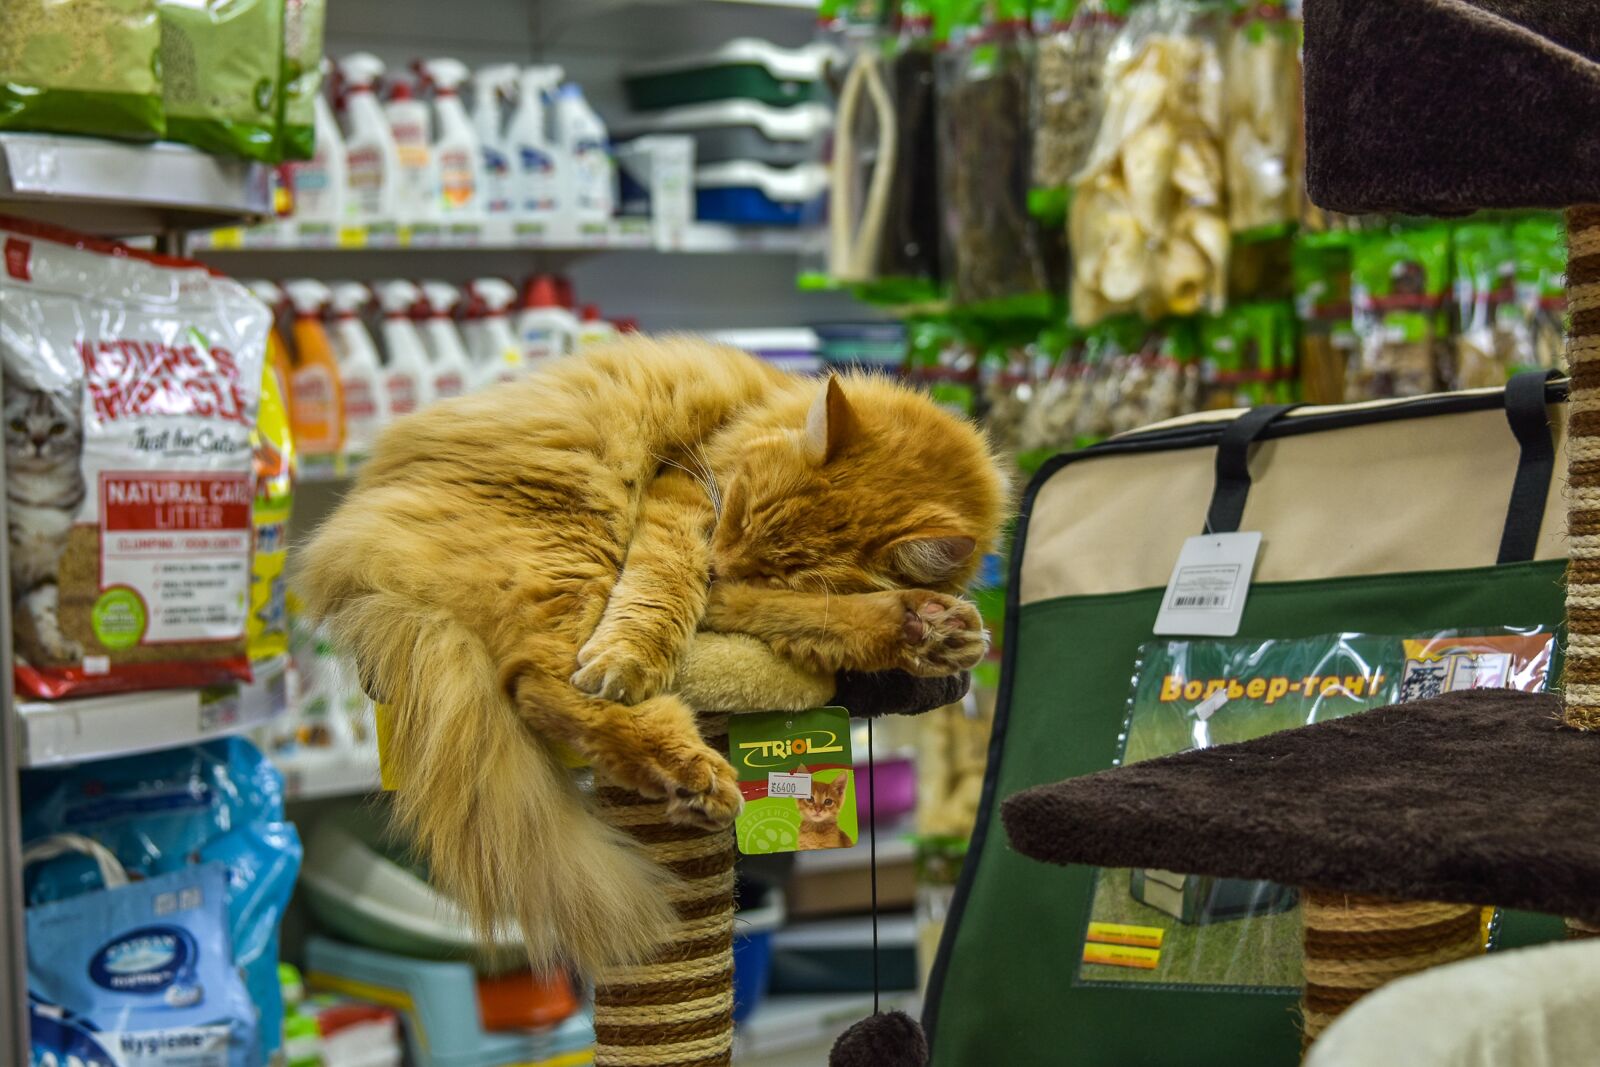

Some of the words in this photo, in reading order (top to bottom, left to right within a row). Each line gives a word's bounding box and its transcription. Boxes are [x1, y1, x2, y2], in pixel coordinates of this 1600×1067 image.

[108, 480, 208, 505] NATURAL
[209, 480, 249, 505] CAR
[155, 504, 224, 528] LITTER
[1160, 674, 1386, 704] Вольер-тент
[776, 782, 796, 793] 6400
